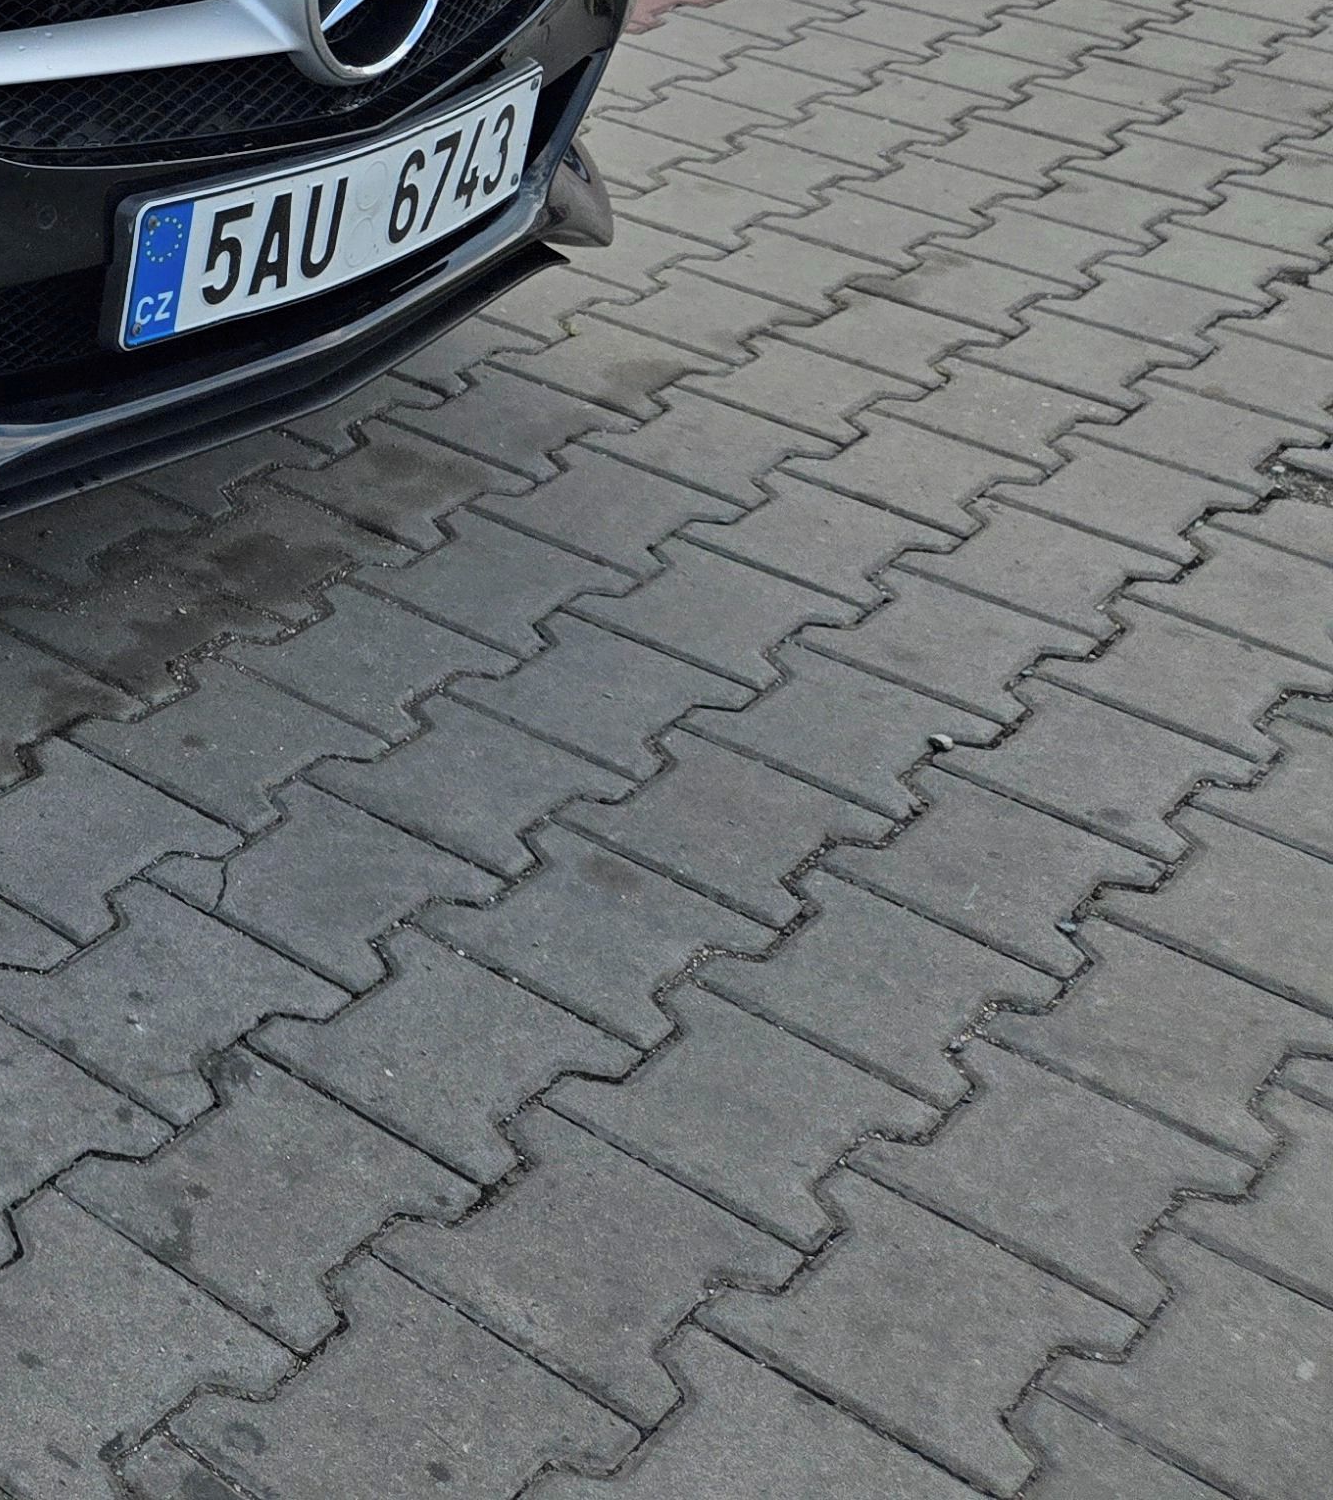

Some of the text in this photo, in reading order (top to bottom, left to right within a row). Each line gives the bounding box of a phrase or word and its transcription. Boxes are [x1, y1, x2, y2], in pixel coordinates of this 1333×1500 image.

[200, 104, 516, 306] 5AU 6743
[135, 291, 173, 325] CZ
